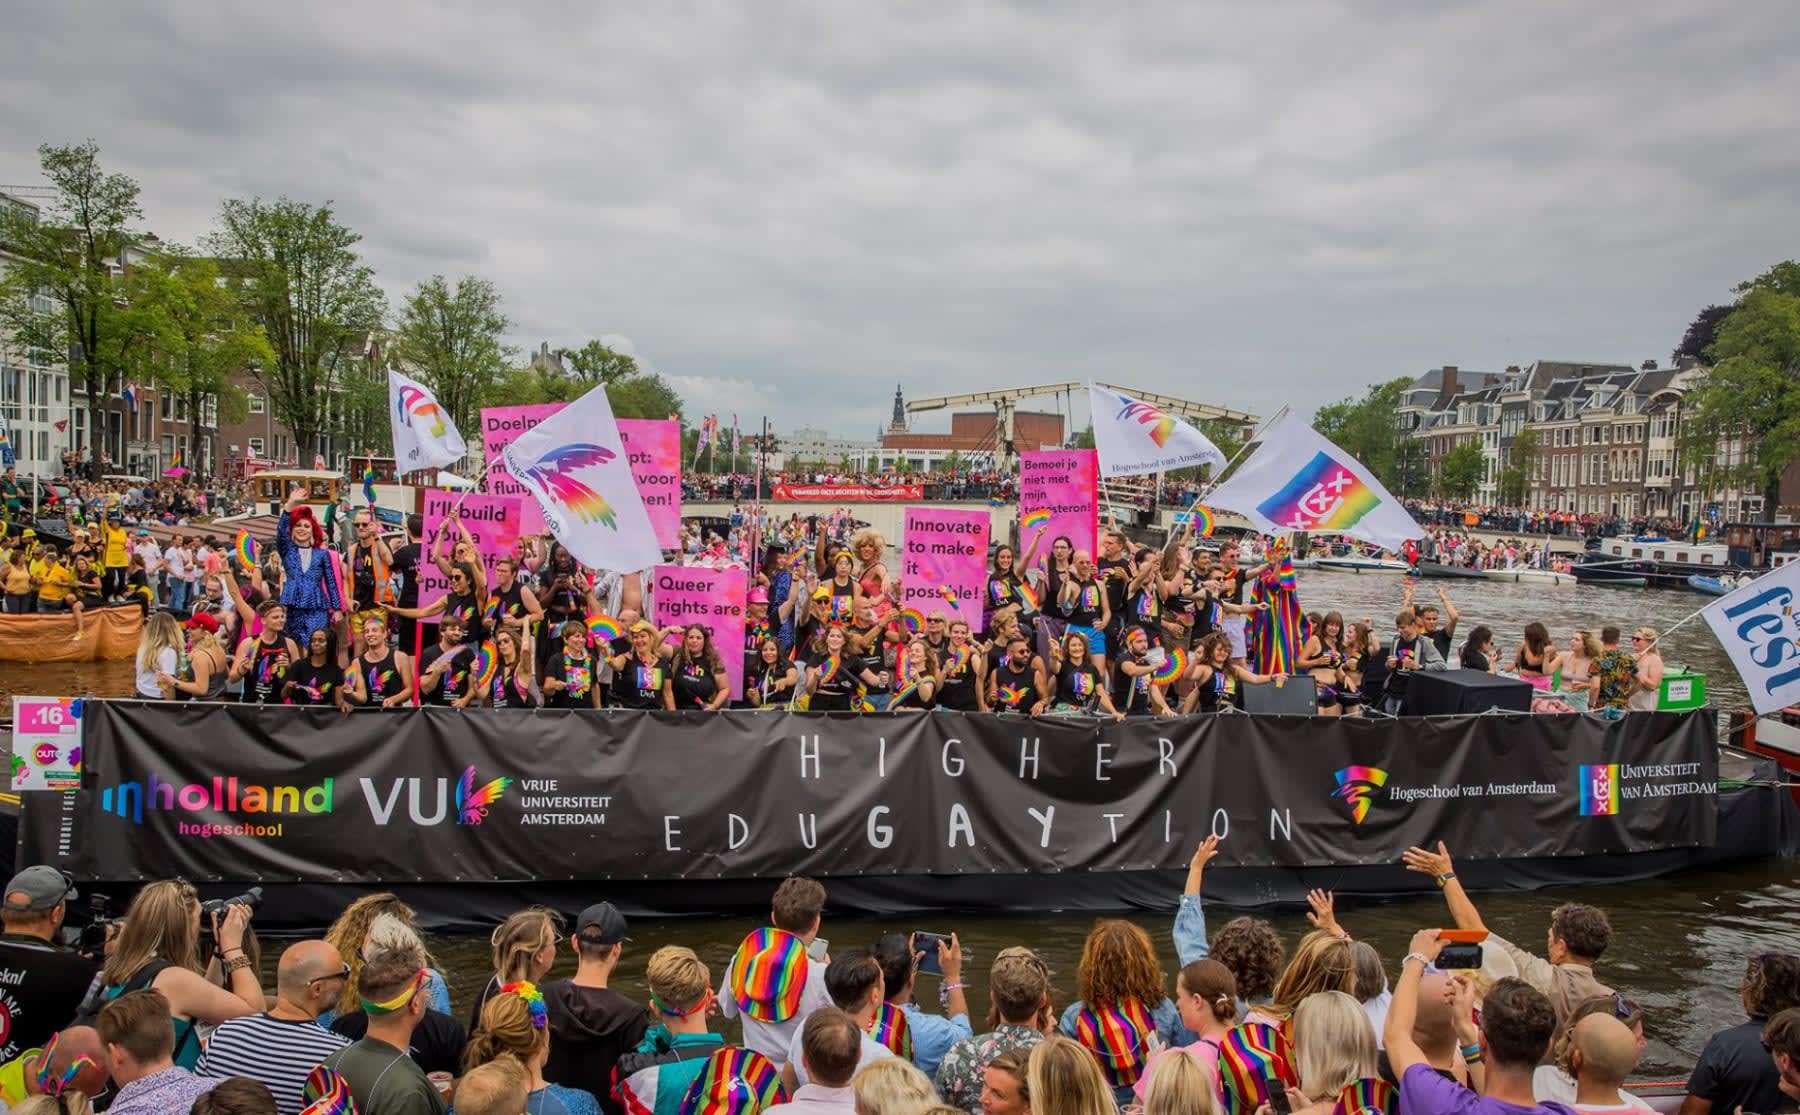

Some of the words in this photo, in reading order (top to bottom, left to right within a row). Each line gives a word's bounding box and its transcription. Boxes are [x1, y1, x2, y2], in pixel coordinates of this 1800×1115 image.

[488, 415, 546, 431] Doelp
[1024, 459, 1065, 470] Bemoei
[1067, 458, 1078, 471] je
[1161, 456, 1177, 466] van
[638, 475, 676, 485] voor
[1024, 475, 1045, 485] niet
[1048, 475, 1070, 484] met
[1024, 490, 1047, 501] mijn
[459, 501, 507, 521] build
[909, 517, 982, 534] Innovate
[471, 532, 480, 543] a
[908, 541, 926, 553] to
[931, 541, 975, 555] make
[907, 561, 918, 575] it
[659, 576, 714, 592] Queer
[905, 584, 979, 601] possle!
[658, 598, 708, 616] rights
[713, 604, 740, 616] are
[801, 735, 1177, 781] HIGHER
[1620, 762, 1701, 779] UNIVERSITEIT
[521, 779, 558, 792] VRIJE
[1389, 784, 1460, 803] Hogeschool
[1462, 786, 1483, 797] van
[1485, 780, 1557, 796] Amsterdam
[1642, 781, 1718, 798] AMSTERDAM
[102, 773, 334, 825] inholland
[359, 777, 448, 826] VU
[521, 796, 612, 809] UNIVERSITEIT
[521, 813, 606, 825] AMSTERDAM
[664, 803, 1291, 851] EDUGAYTION
[178, 820, 283, 838] hogeschool
